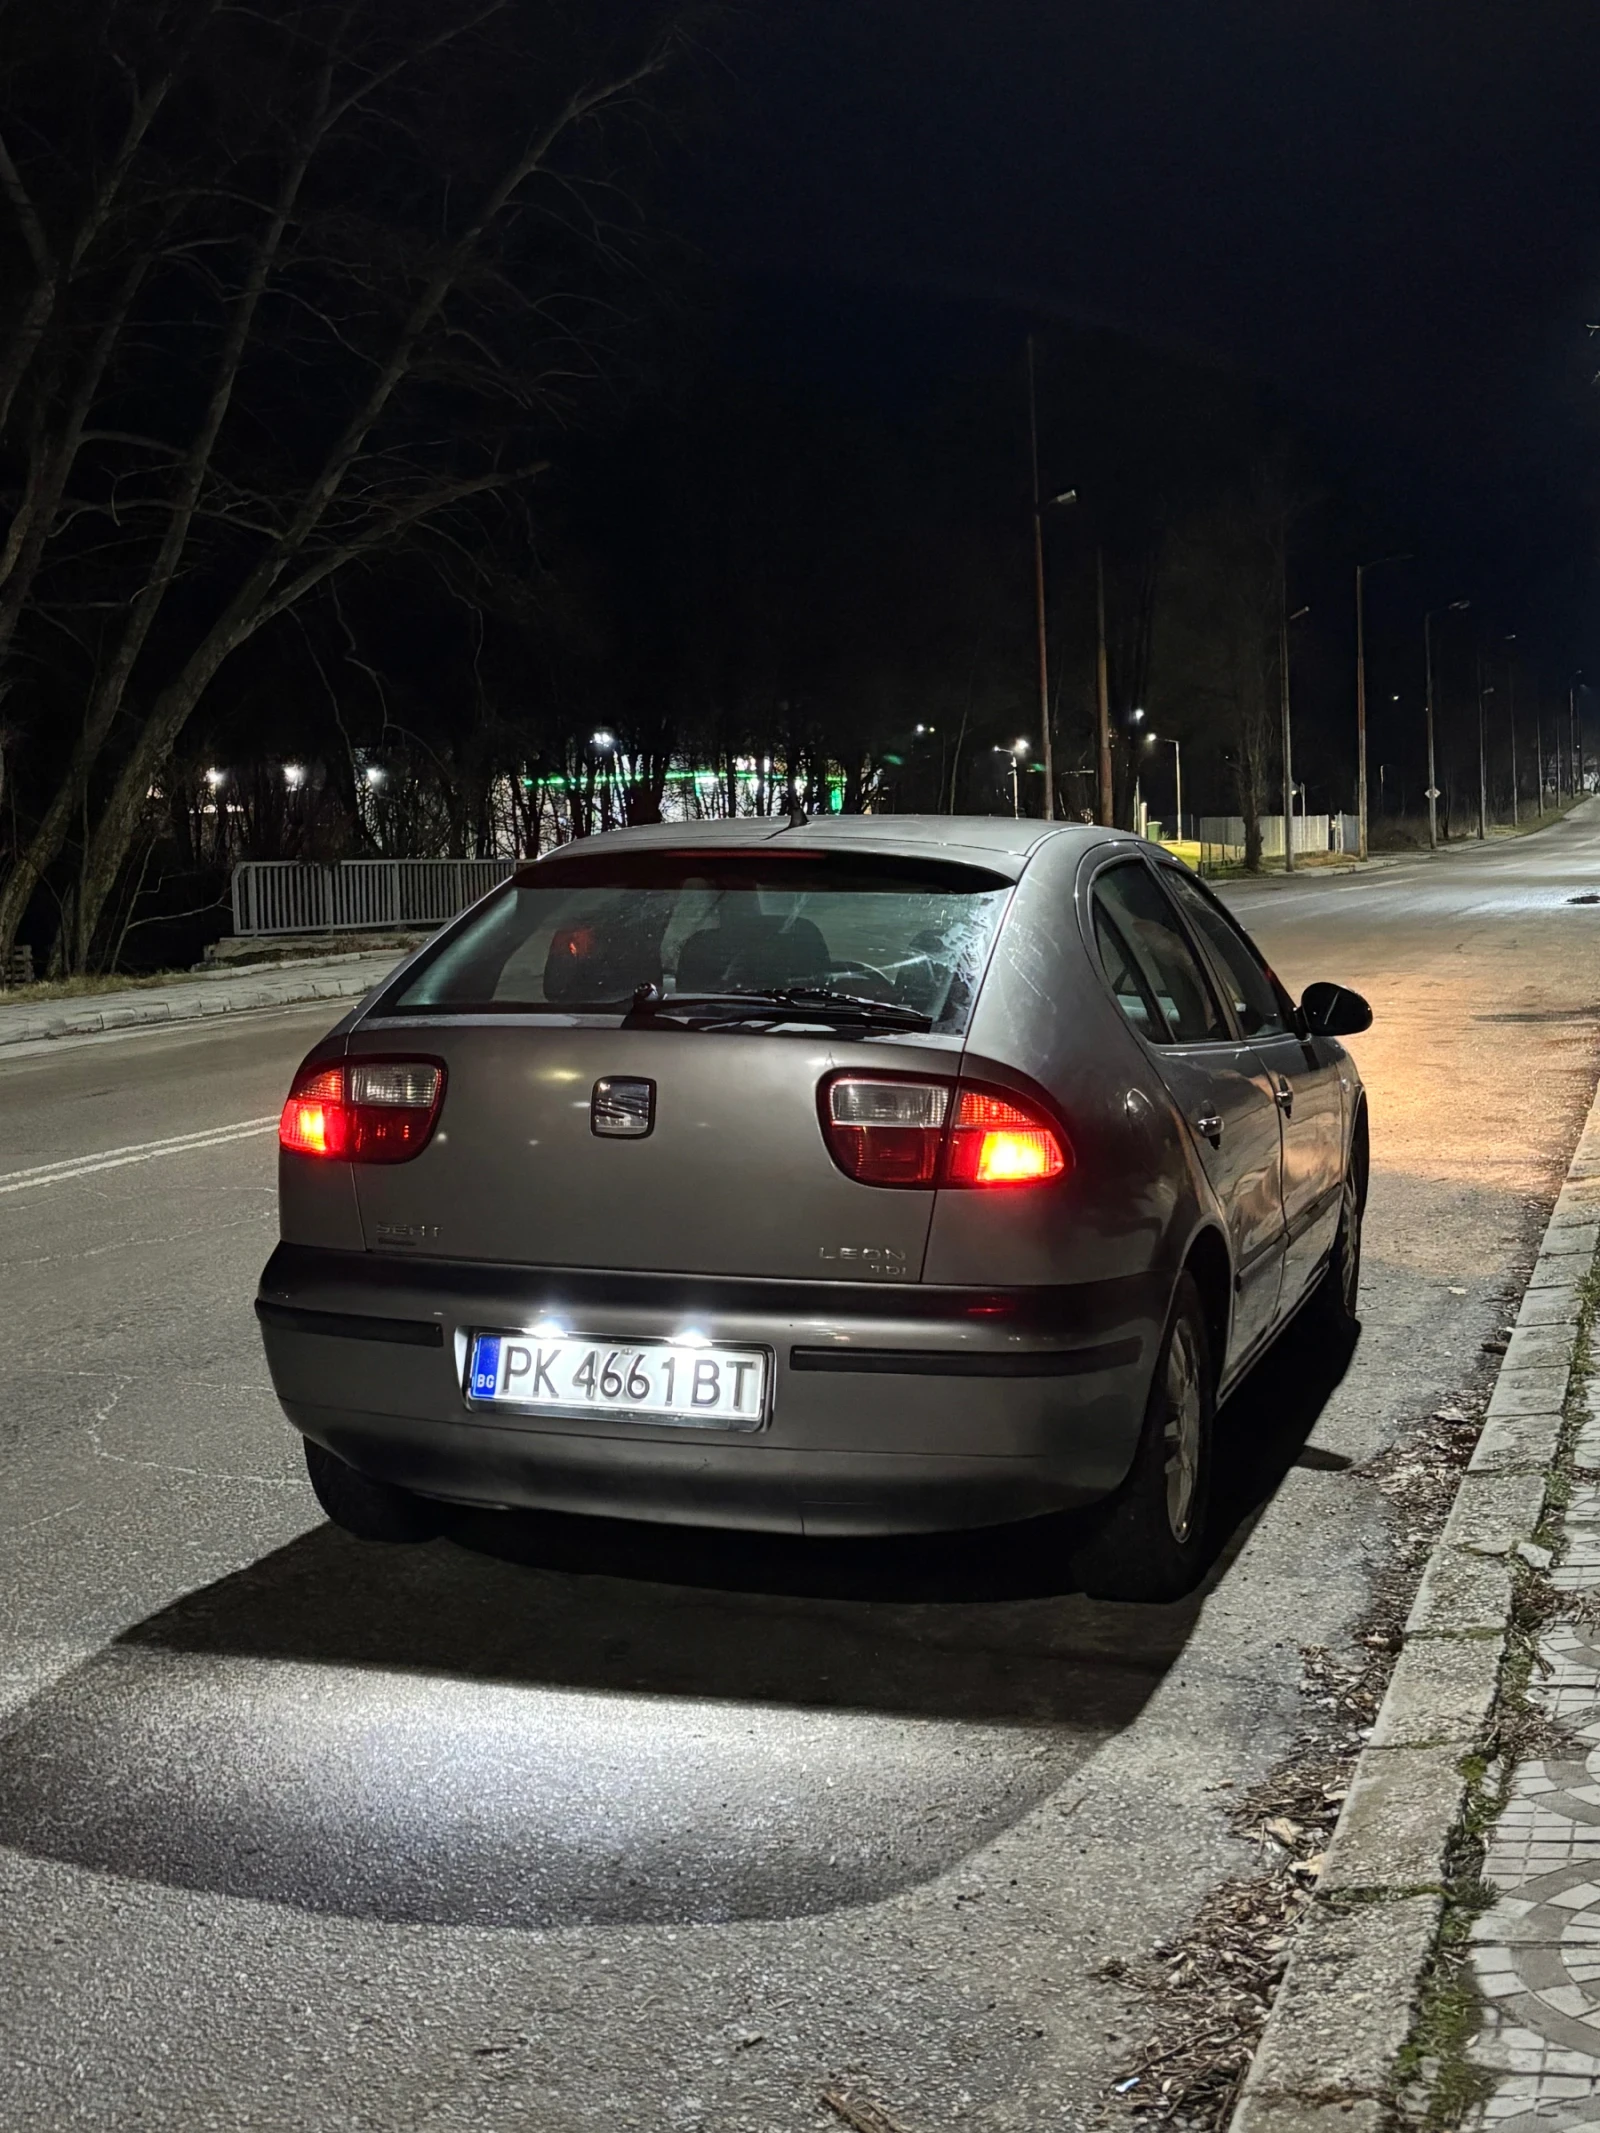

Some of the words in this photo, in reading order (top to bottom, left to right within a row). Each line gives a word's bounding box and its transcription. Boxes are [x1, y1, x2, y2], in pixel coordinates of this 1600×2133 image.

[819, 1246, 906, 1261] LEON
[870, 1264, 907, 1276] TDI
[476, 1373, 495, 1389] BG
[502, 1345, 562, 1398] PK
[571, 1350, 676, 1407] 4661
[690, 1359, 757, 1411] BT
